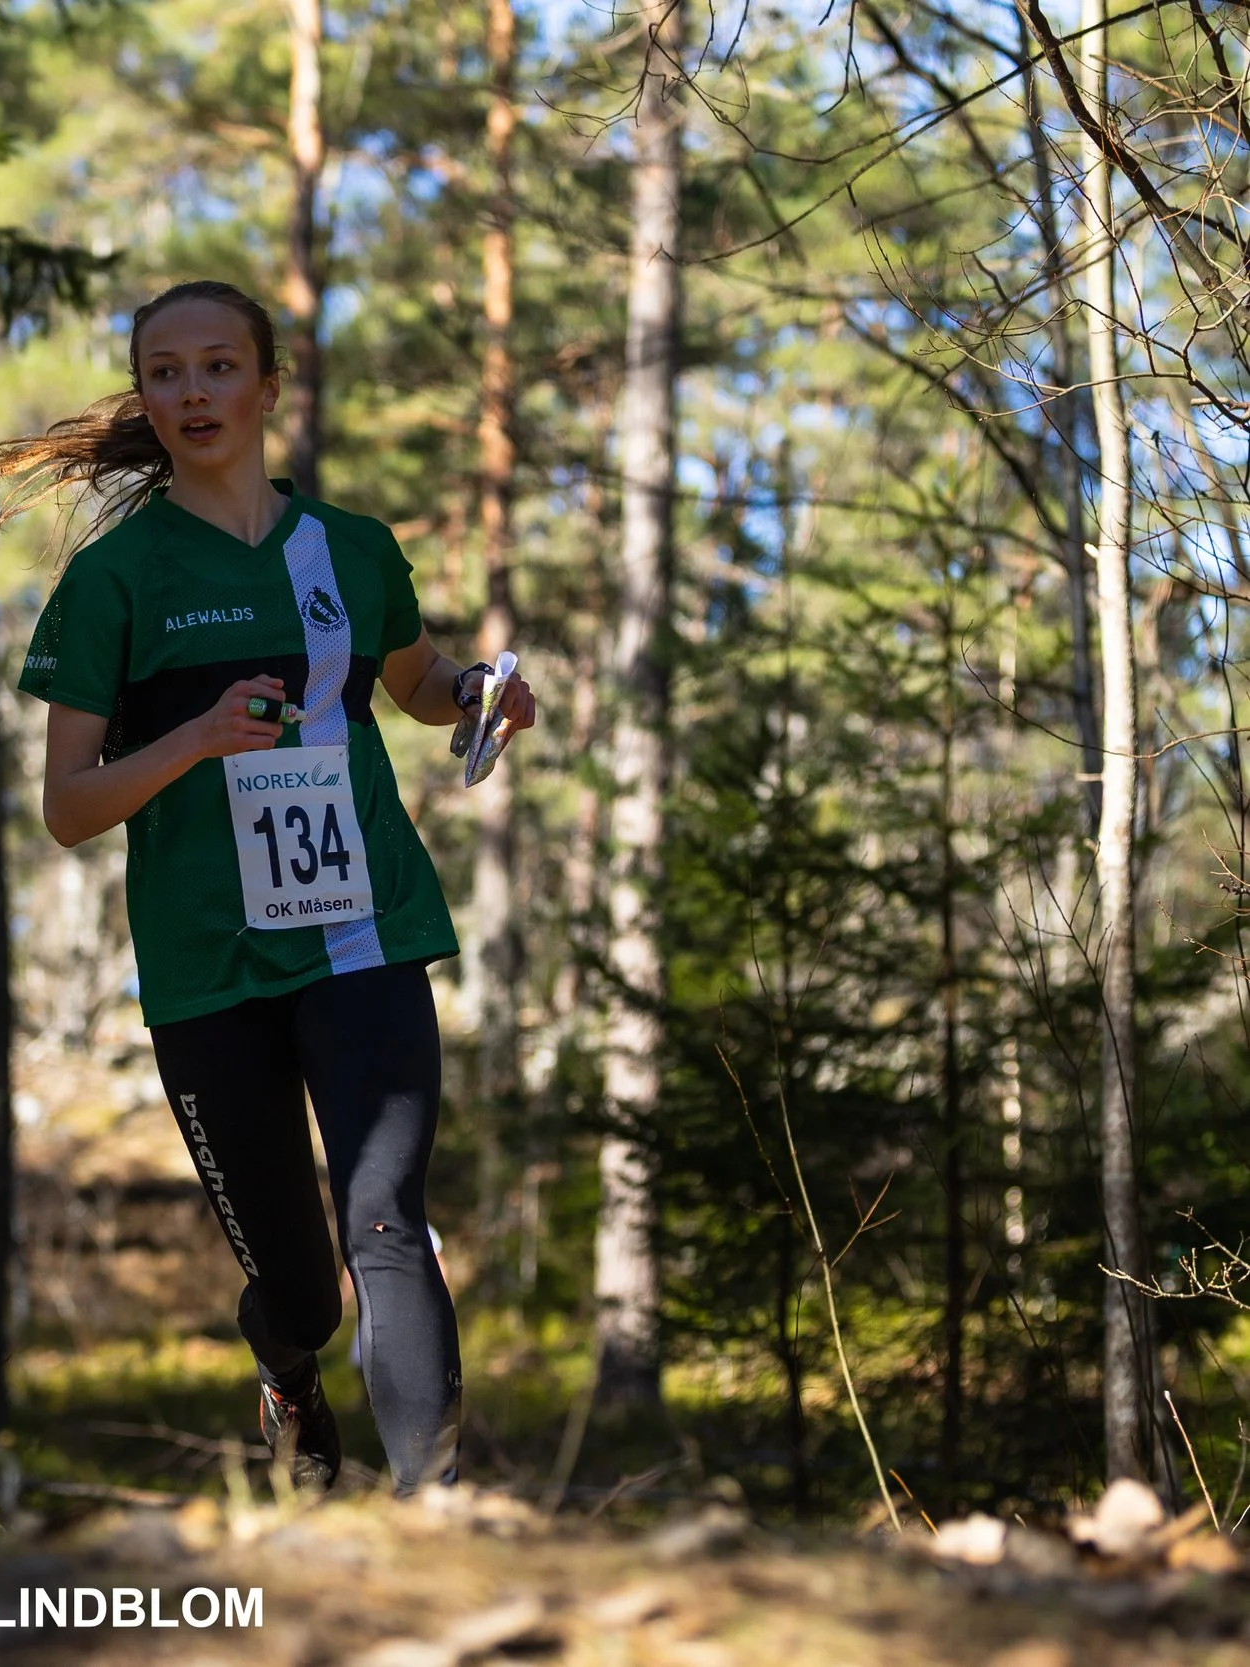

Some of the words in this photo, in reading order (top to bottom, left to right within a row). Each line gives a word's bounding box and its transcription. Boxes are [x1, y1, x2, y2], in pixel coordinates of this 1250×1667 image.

[165, 607, 254, 632] ALEWALDS
[237, 771, 310, 793] NOREX
[253, 803, 350, 888] 134
[265, 901, 293, 918] OK
[299, 898, 353, 915] Måsen
[180, 1093, 259, 1277] bagheera
